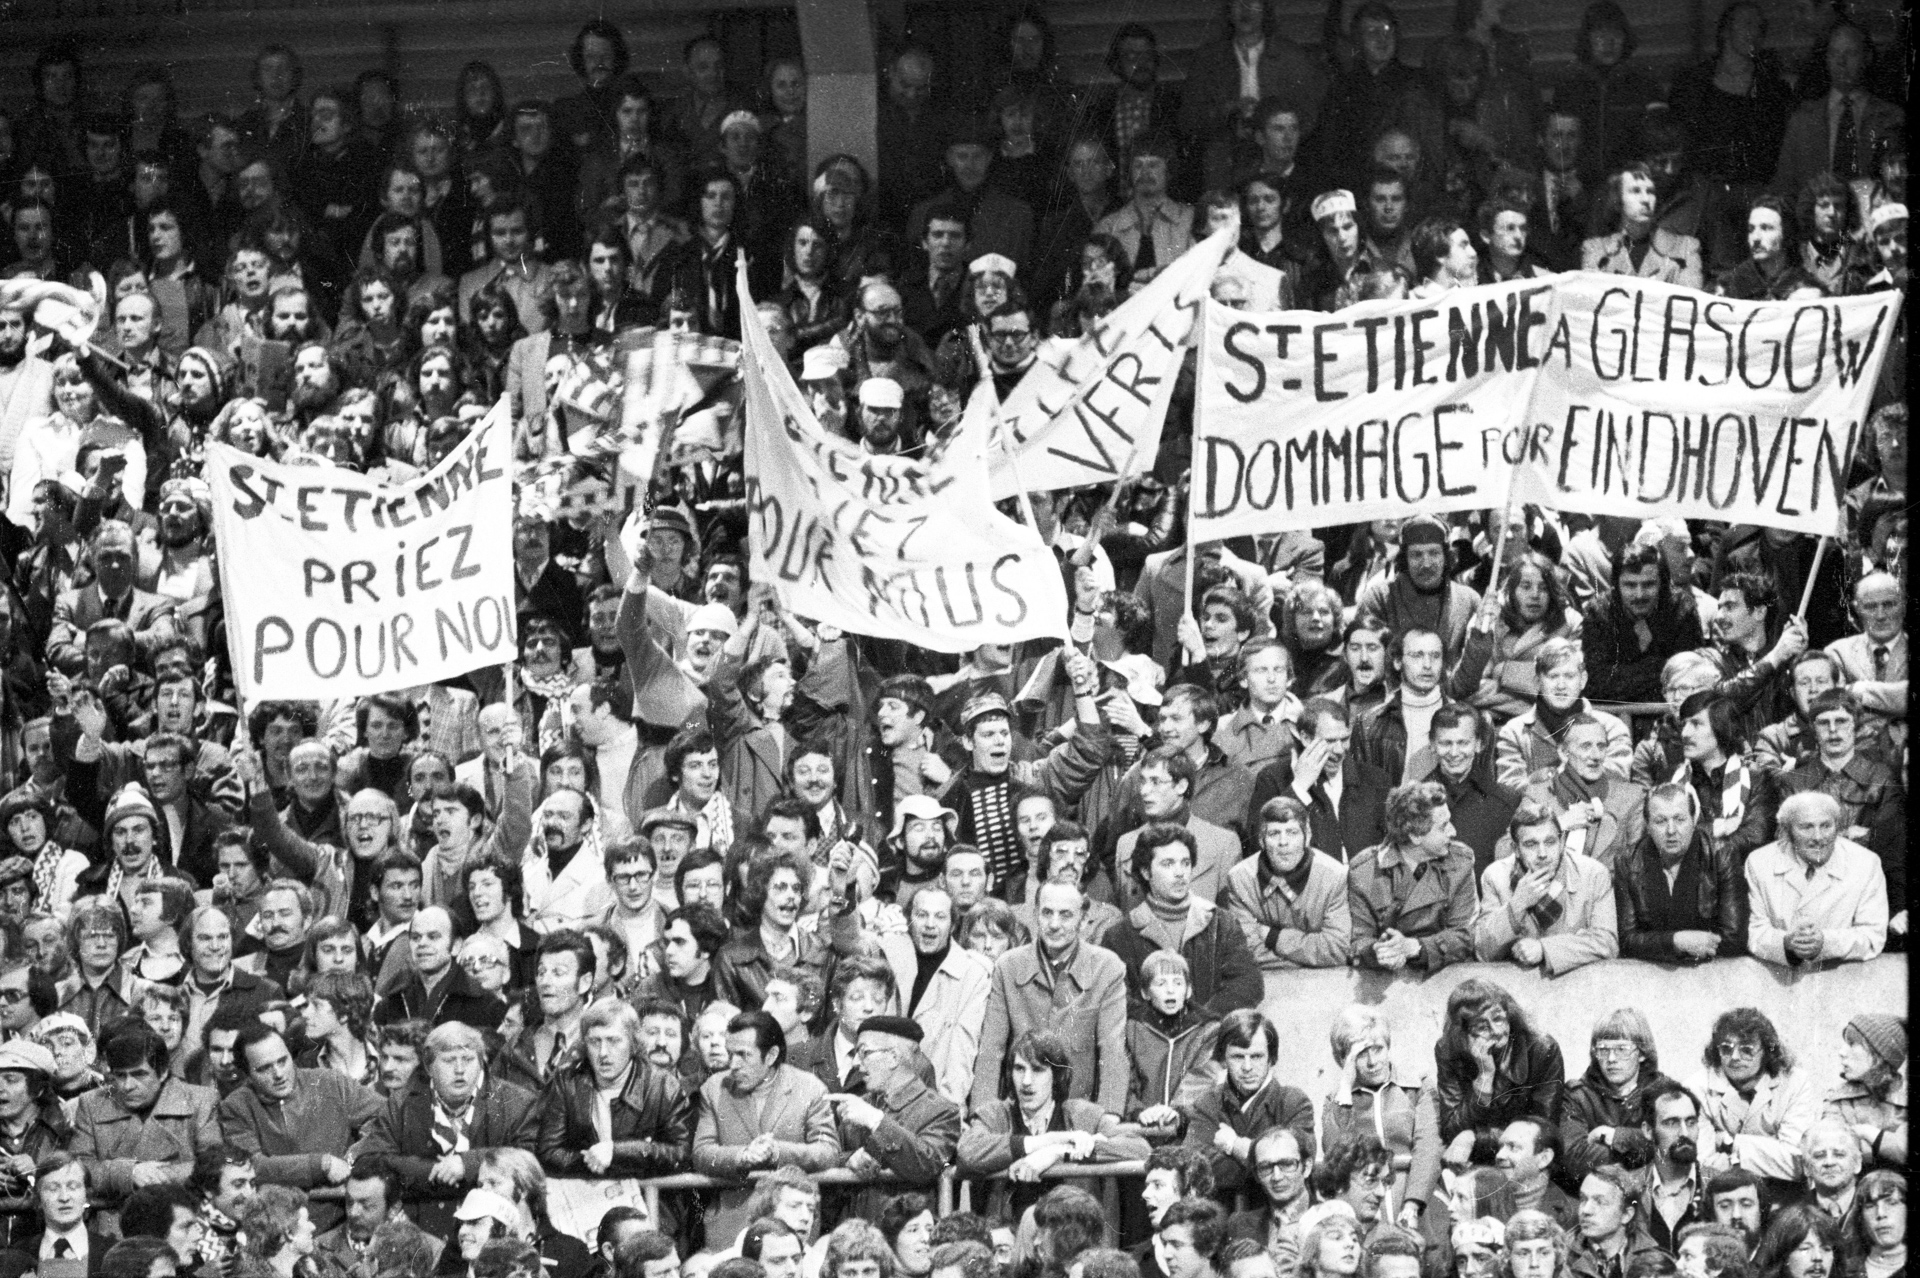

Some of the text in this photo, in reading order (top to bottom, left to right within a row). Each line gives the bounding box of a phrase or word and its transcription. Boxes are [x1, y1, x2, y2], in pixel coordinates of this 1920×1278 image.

[1543, 312, 1571, 373] A
[1590, 287, 1889, 394] GLASGOW
[1194, 403, 1478, 519] DOMMAGE
[1556, 405, 1858, 516] EINDHOVEN
[253, 612, 419, 686] POUR
